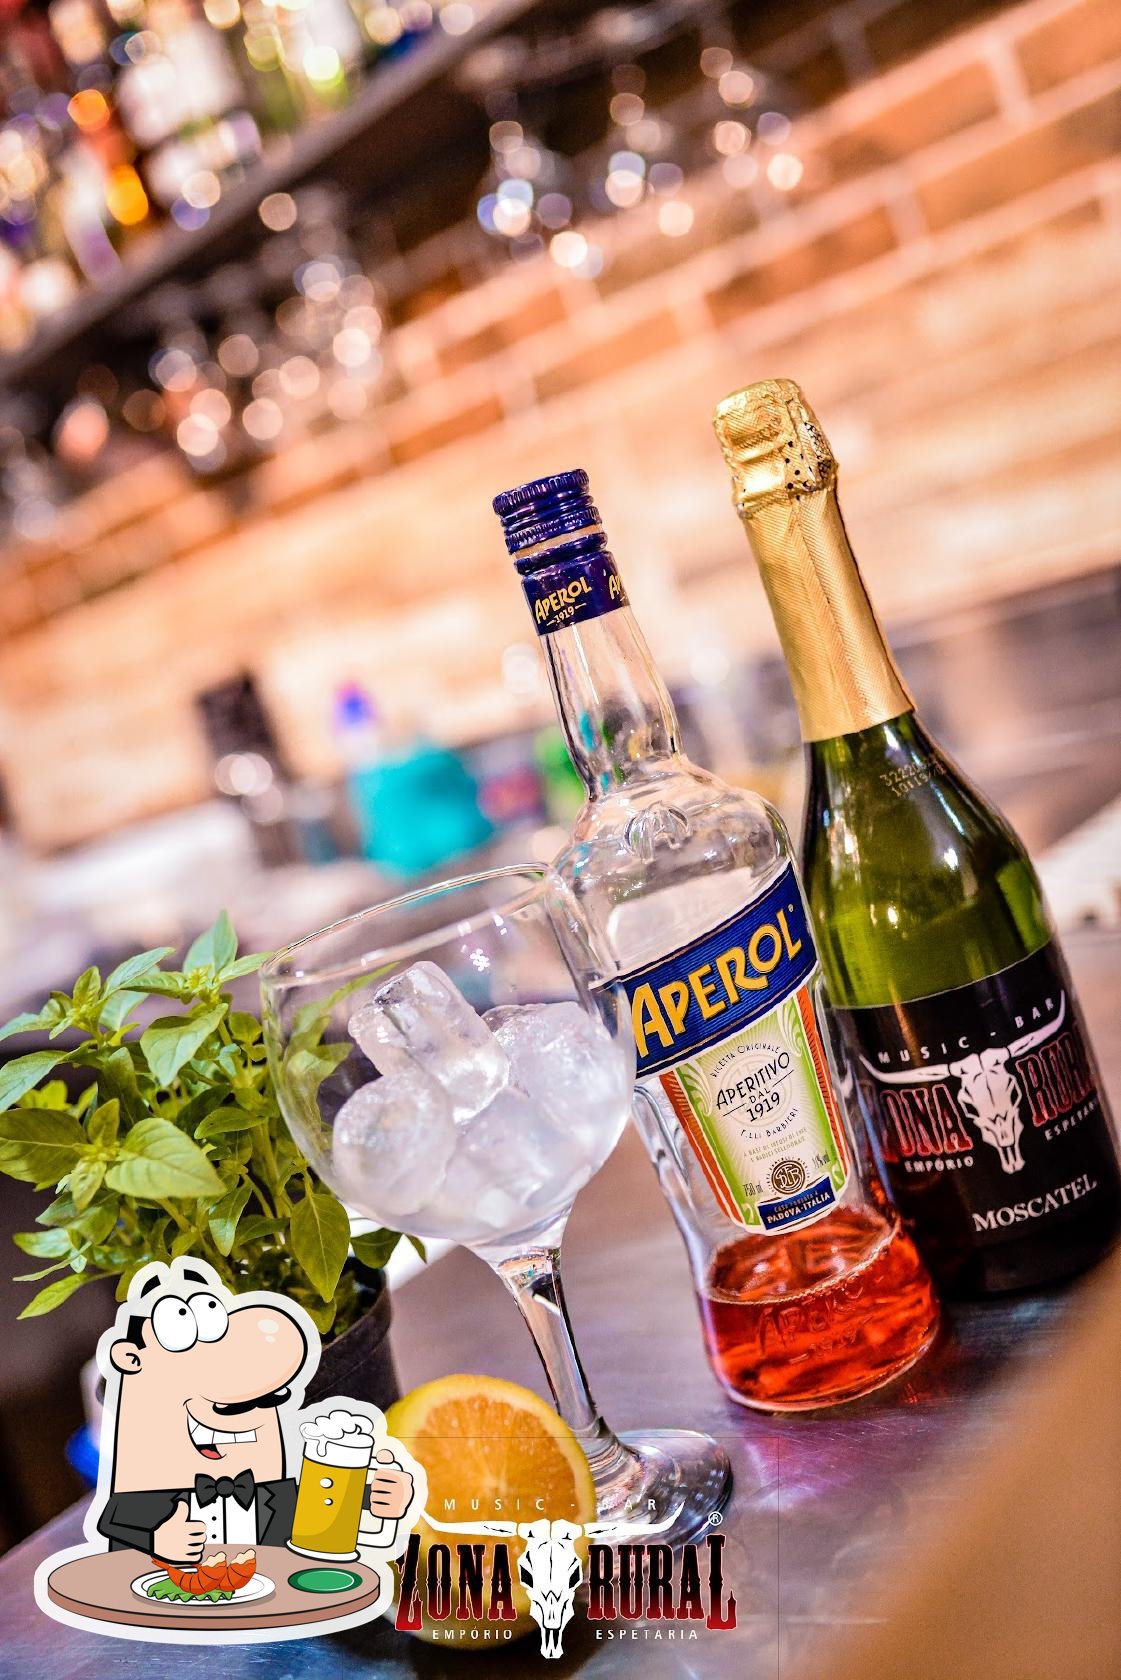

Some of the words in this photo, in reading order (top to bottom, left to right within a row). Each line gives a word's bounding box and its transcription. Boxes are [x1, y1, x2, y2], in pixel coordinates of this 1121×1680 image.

[535, 576, 592, 624] APEROL
[554, 606, 575, 624] 1919
[632, 909, 802, 1058] APEROL
[878, 1036, 970, 1064] MUSIC
[1015, 998, 1054, 1028] BAR
[716, 1052, 790, 1110] APERITIVO
[746, 1092, 780, 1122] 1919
[749, 1087, 771, 1104] DAL
[870, 1083, 974, 1164] ONA
[971, 1173, 1099, 1232] MOSCATEL
